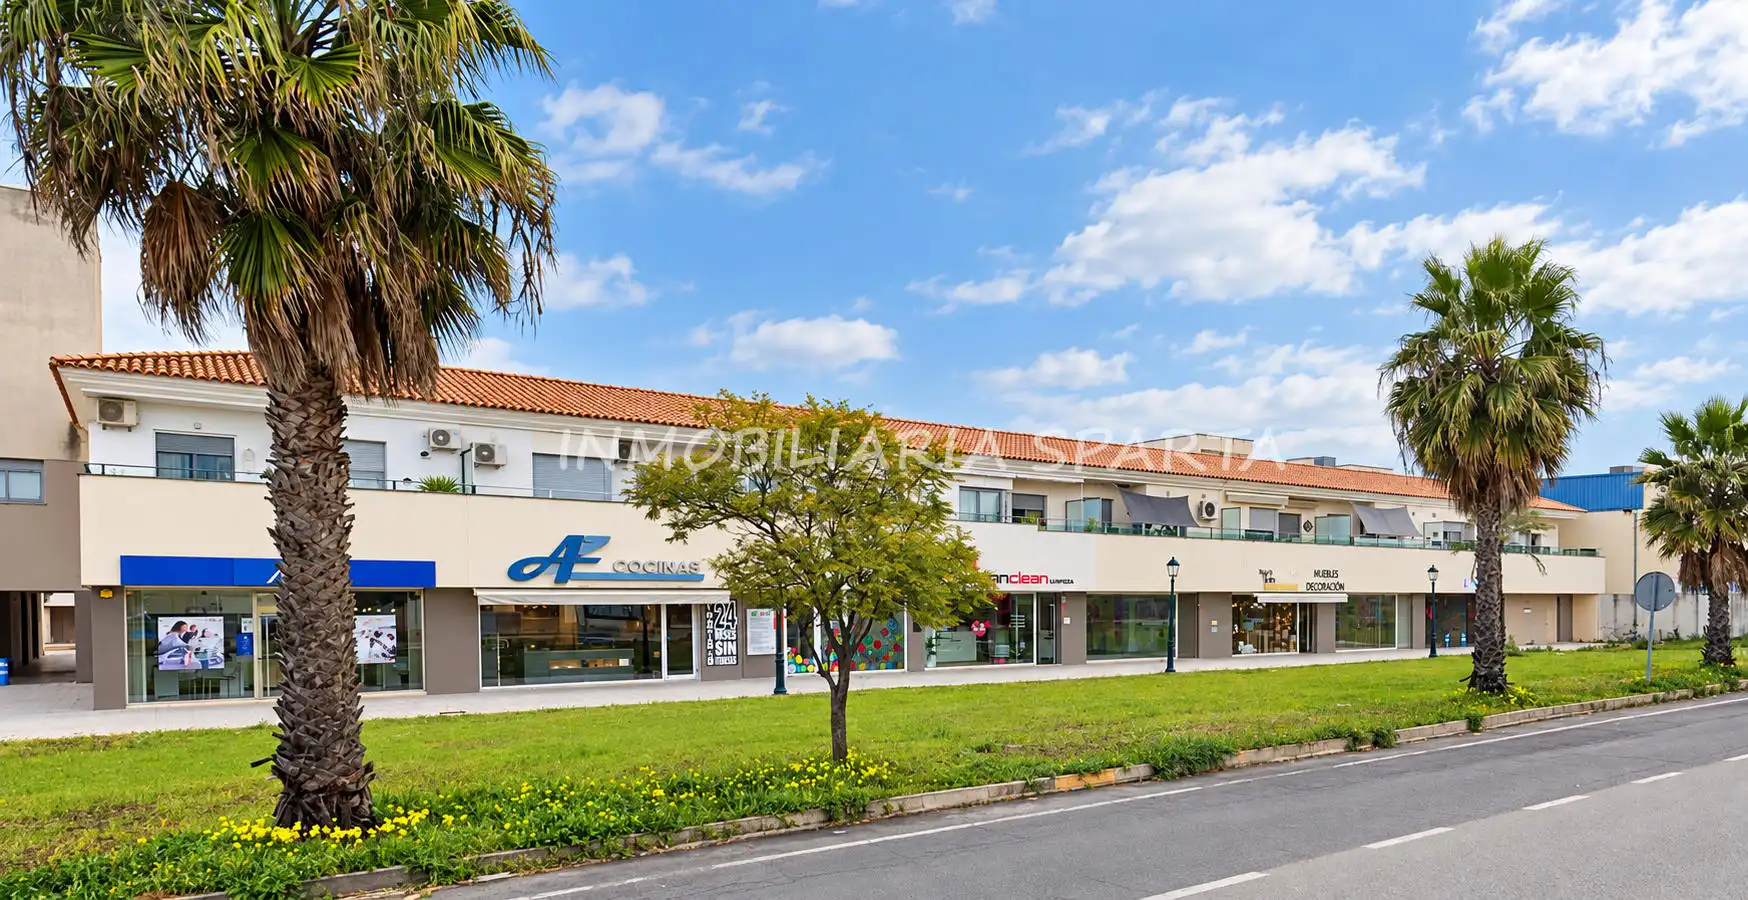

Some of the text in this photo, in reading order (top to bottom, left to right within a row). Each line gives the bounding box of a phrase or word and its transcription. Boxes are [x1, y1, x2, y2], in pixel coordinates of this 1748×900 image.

[612, 560, 700, 574] COCINAS
[1313, 569, 1339, 579] MUEBLES
[1305, 581, 1345, 591] DECORACIÓN
[714, 601, 737, 629] 24
[714, 641, 737, 656] SIN
